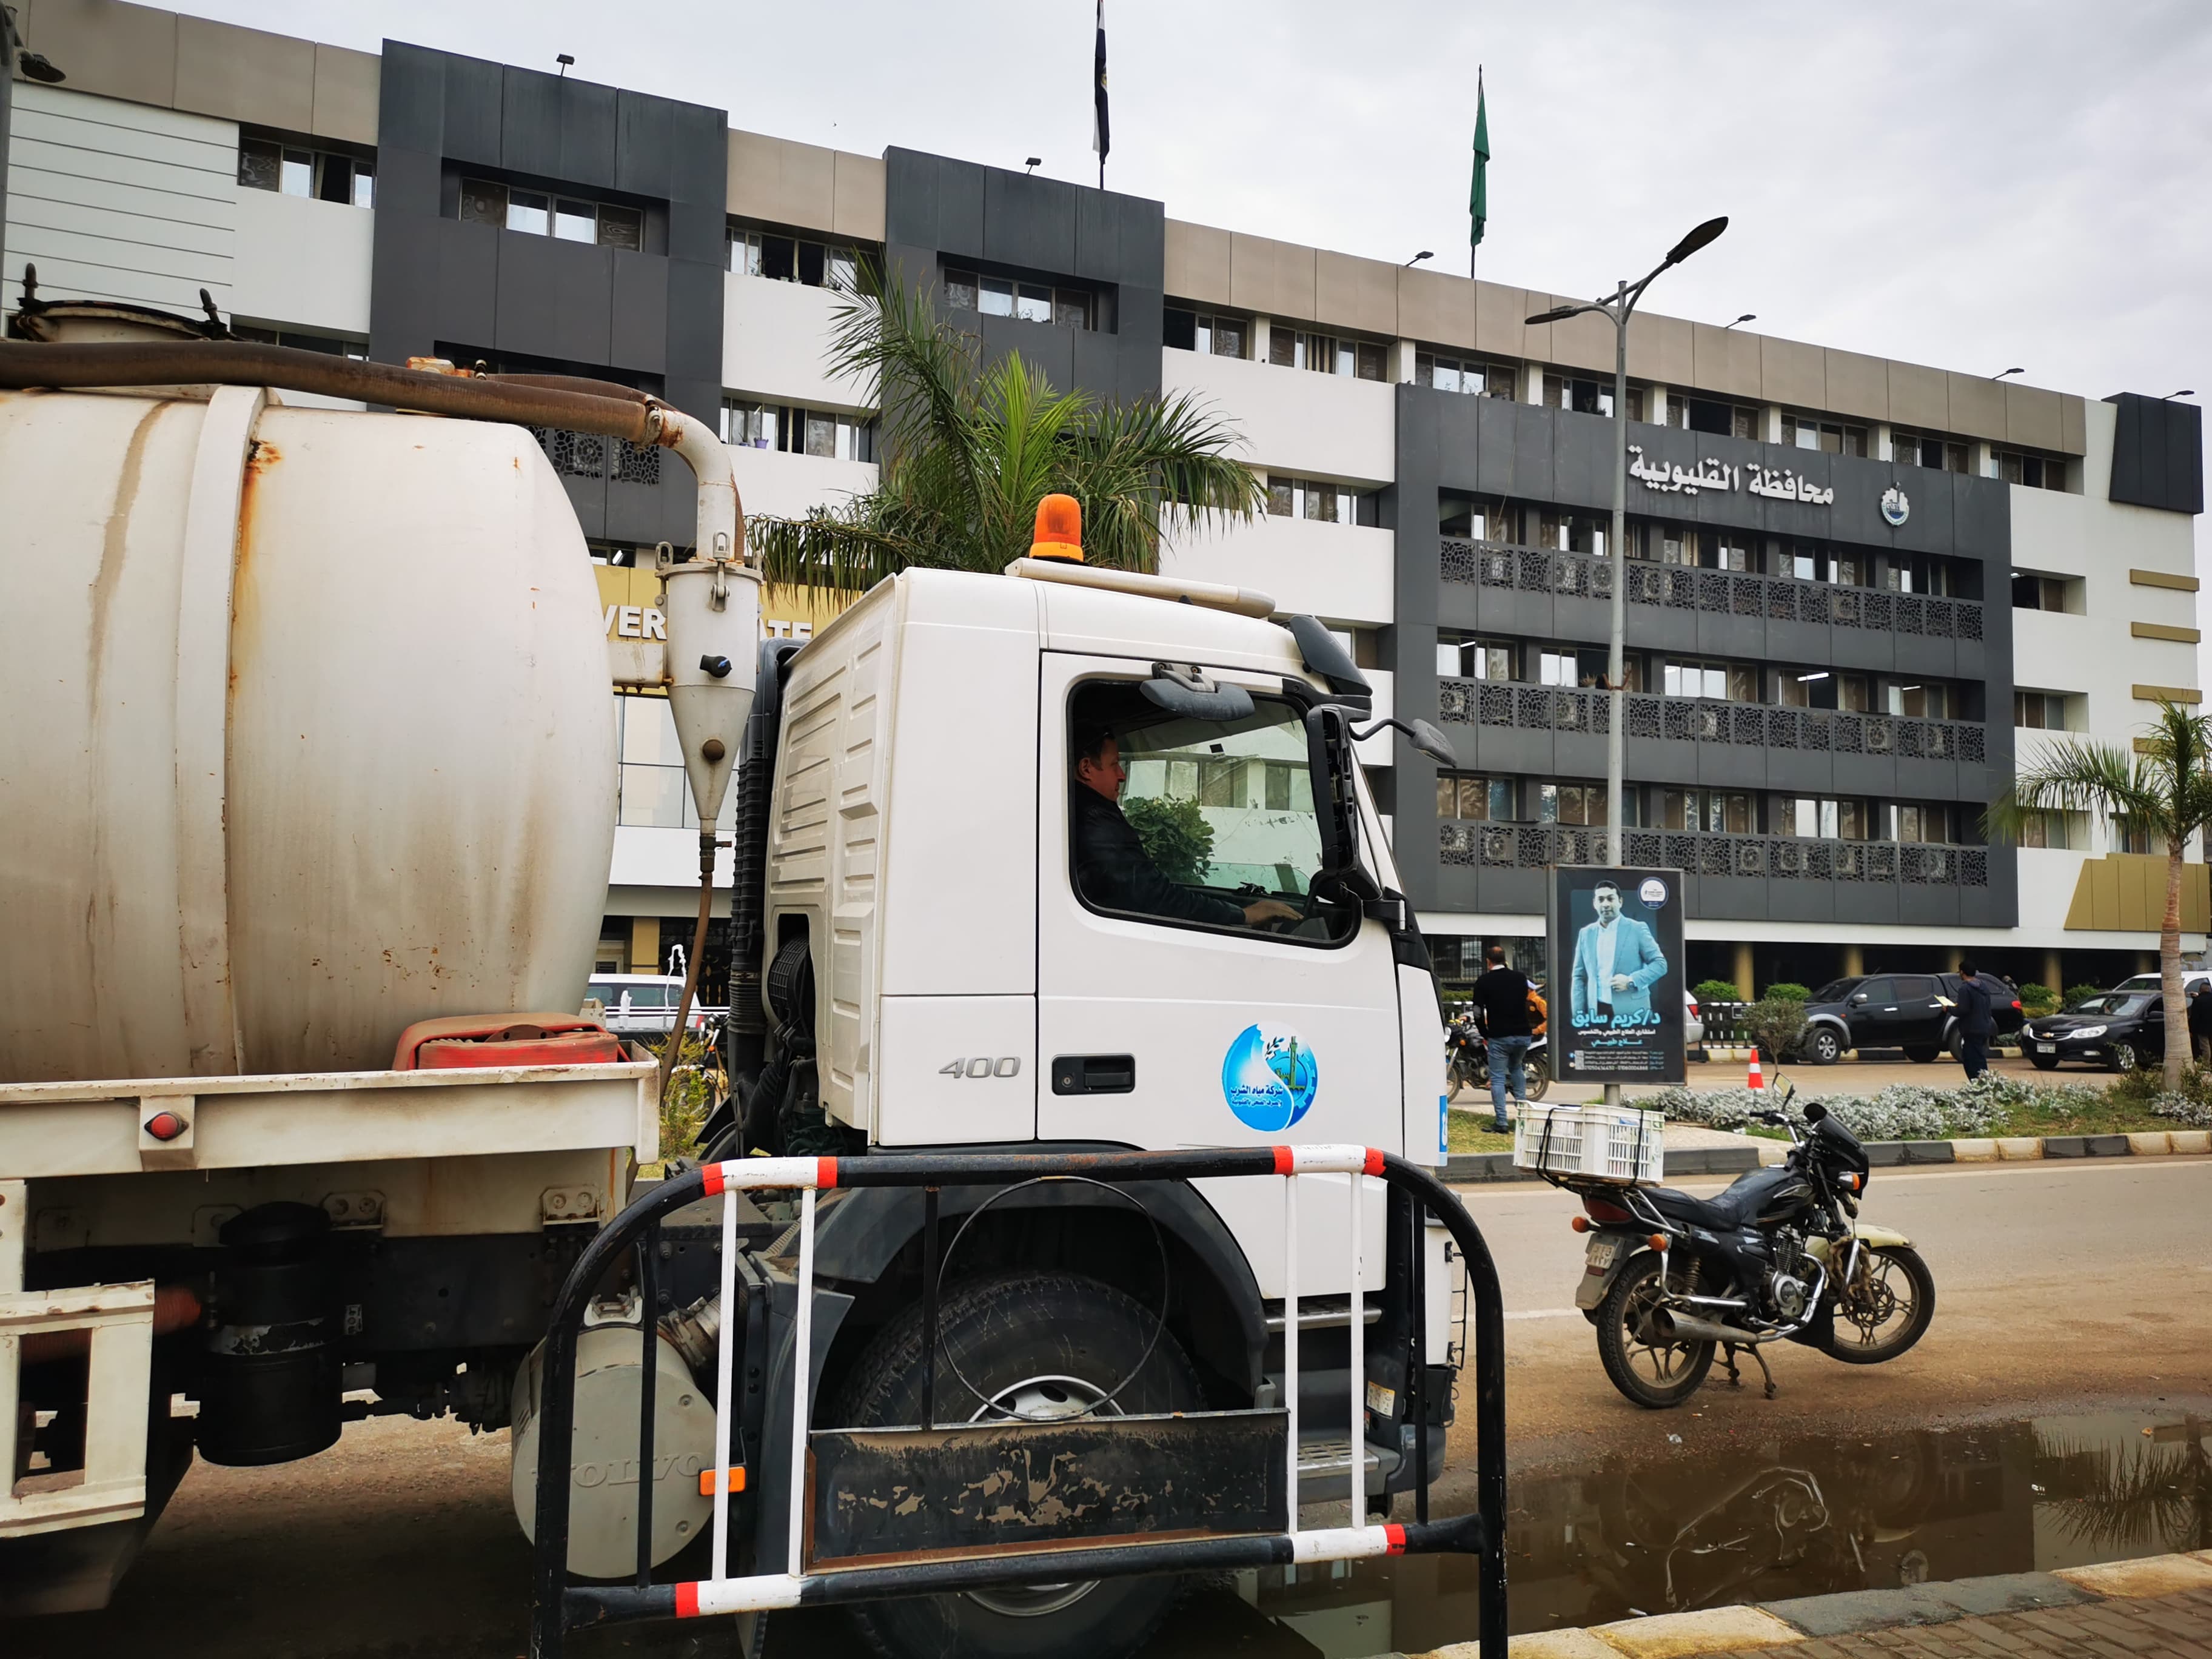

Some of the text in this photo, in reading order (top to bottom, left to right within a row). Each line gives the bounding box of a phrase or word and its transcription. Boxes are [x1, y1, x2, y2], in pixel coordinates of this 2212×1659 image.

[1627, 444, 1835, 505] محافظة القليوبية
[1571, 1009, 1608, 1027] سابق
[939, 1056, 1021, 1079] 400
[1230, 1084, 1283, 1098] شركة مياه الشرب
[531, 1452, 710, 1488] OLVO
